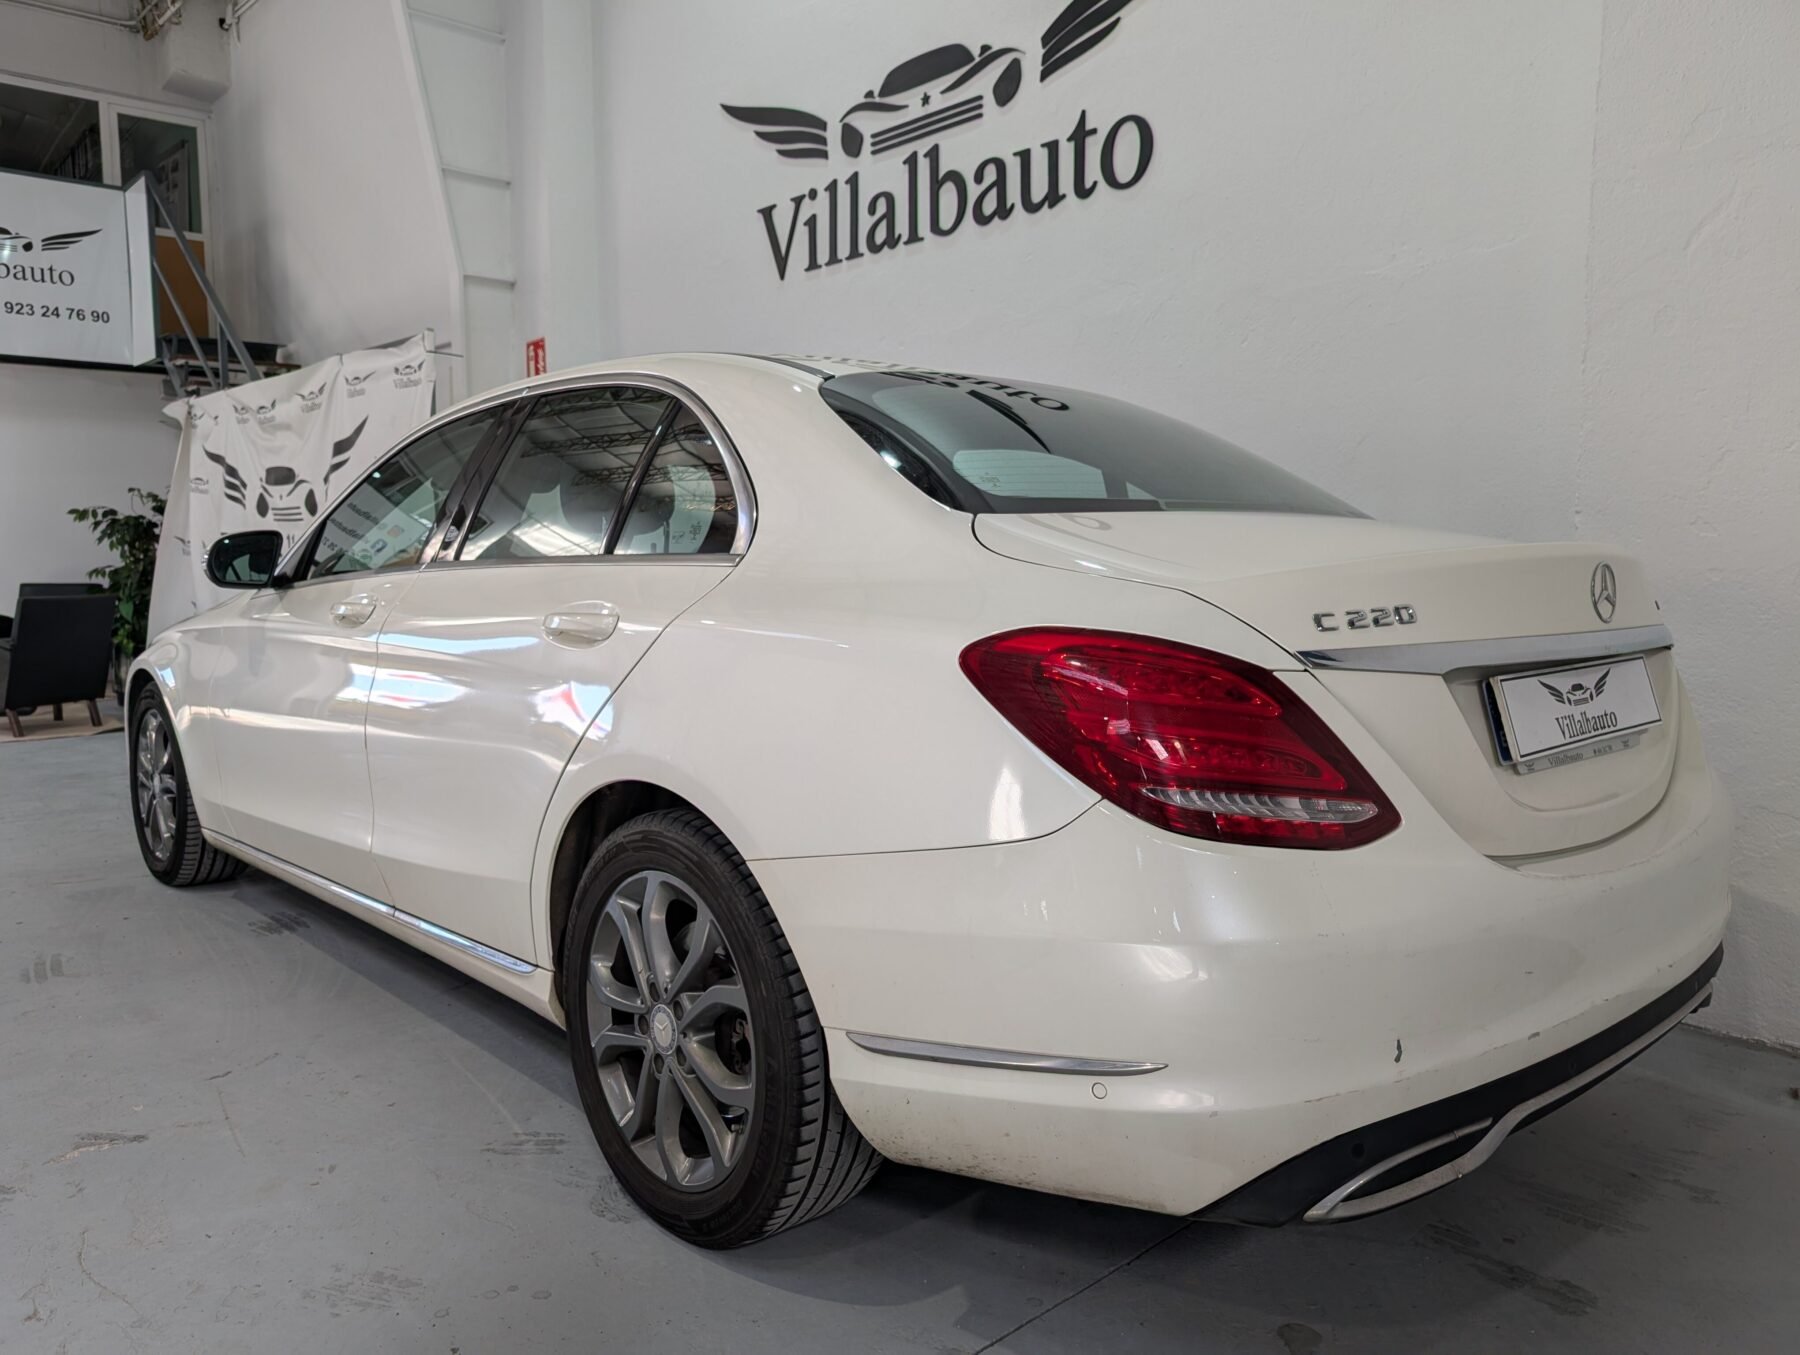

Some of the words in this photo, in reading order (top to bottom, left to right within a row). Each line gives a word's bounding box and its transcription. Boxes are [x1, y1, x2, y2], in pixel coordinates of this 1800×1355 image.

[757, 109, 1154, 281] Villalbauto
[4, 301, 35, 316] 923
[41, 305, 60, 319] 24
[66, 307, 86, 321] 76
[91, 310, 110, 324] 90
[1312, 612, 1339, 632] C
[1345, 604, 1417, 630] 220
[1555, 709, 1618, 741] Villalbauto
